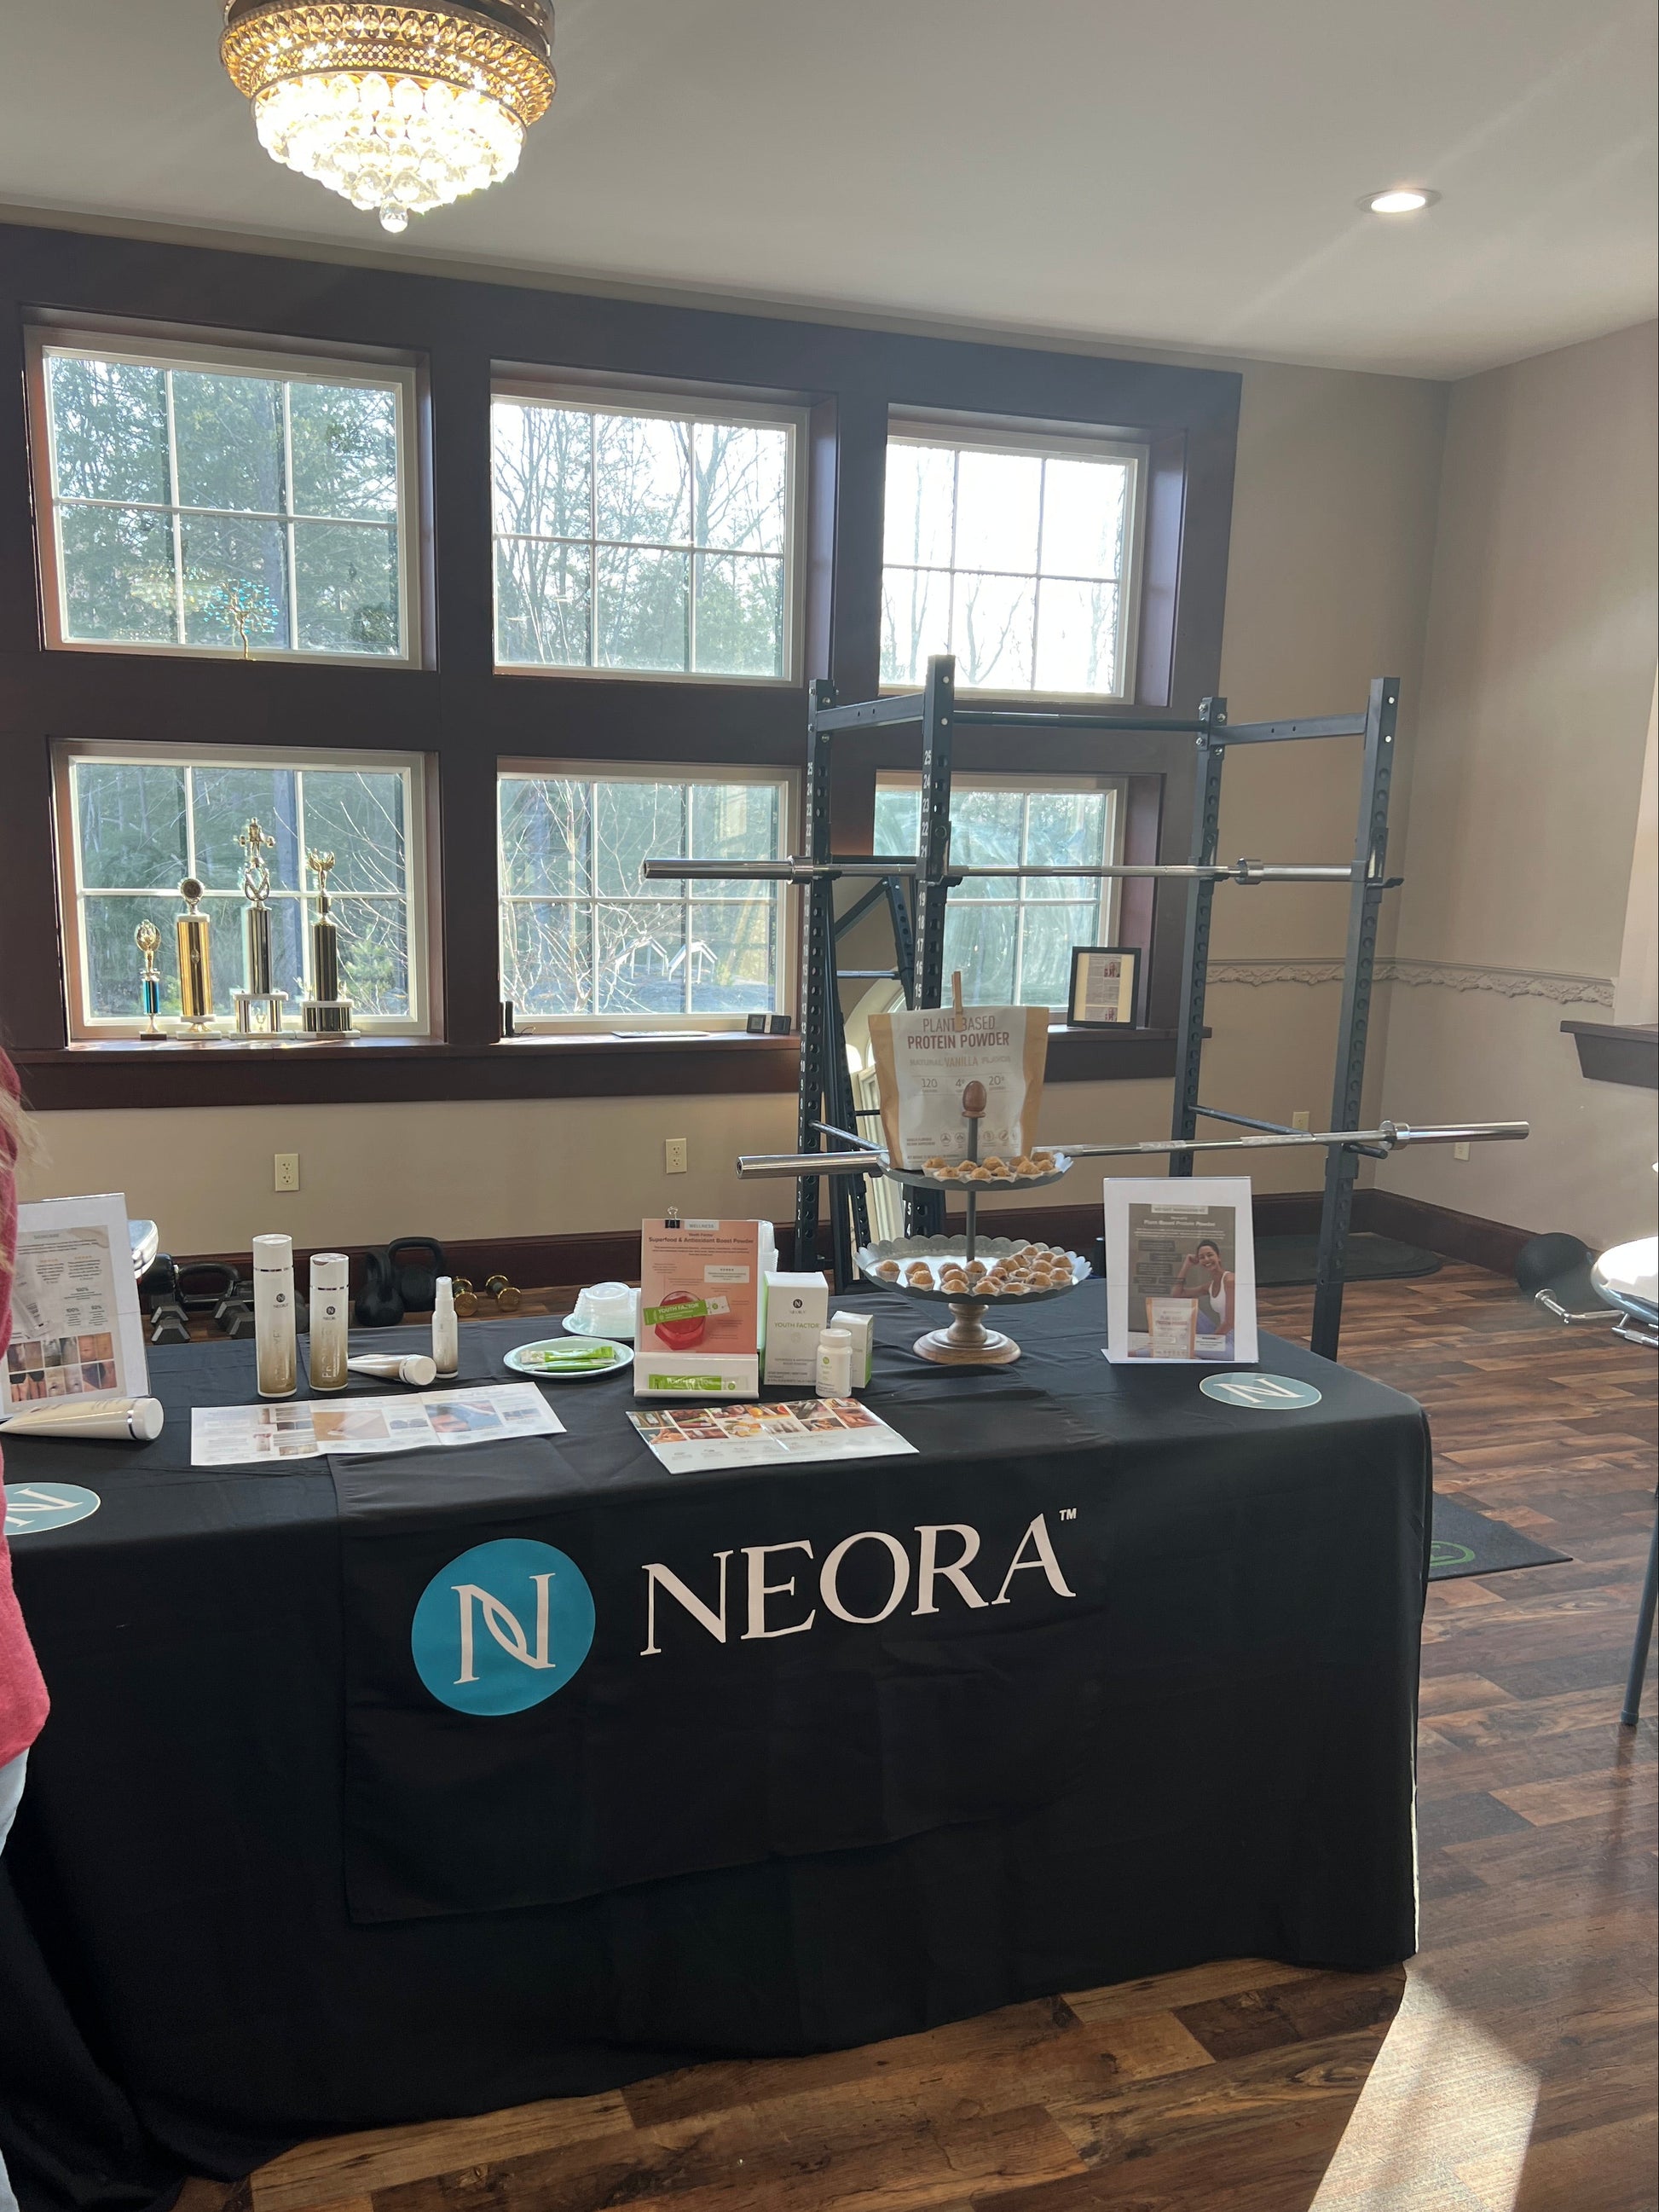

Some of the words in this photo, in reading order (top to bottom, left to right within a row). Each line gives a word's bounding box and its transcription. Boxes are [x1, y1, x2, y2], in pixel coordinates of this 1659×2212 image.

[924, 750, 932, 765] 25
[923, 774, 930, 789] 24
[922, 798, 929, 813] 23
[922, 821, 928, 836] 22
[921, 845, 927, 858] 21
[919, 892, 925, 906] 19
[918, 915, 925, 929] 18
[917, 938, 924, 953] 17
[916, 961, 923, 975] 16
[915, 983, 922, 998] 15
[907, 1035, 956, 1049] PROTEIN
[960, 1032, 1009, 1048] POWDER
[945, 1057, 979, 1067] VANILLA
[922, 1078, 938, 1088] 120
[907, 1202, 912, 1215] 5
[906, 1224, 910, 1236] 4
[640, 1513, 1077, 1656] NEORA
[450, 1572, 556, 1685] N
